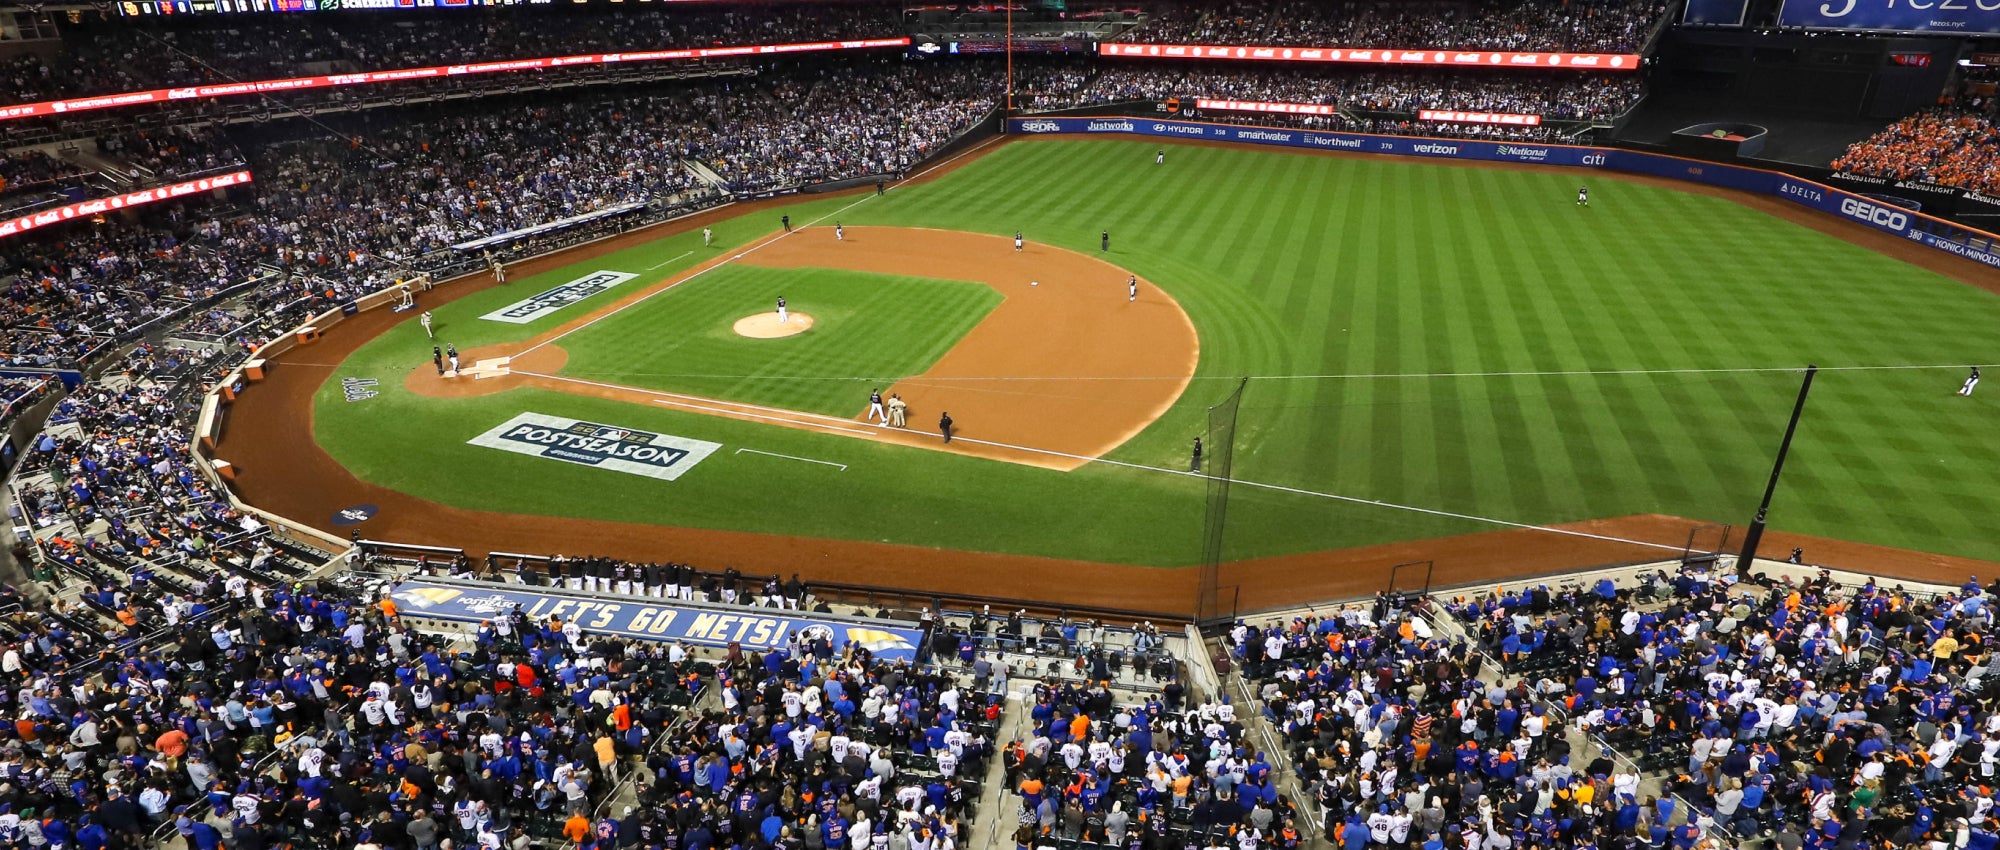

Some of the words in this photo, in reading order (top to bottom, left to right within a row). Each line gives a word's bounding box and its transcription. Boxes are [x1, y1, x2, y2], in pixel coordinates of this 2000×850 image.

[1930, 20, 1966, 28] tezos.nyc
[1088, 121, 1134, 131] Justworks
[1167, 125, 1204, 134] HYUNDAI
[1238, 130, 1291, 142] smartwater
[1314, 136, 1361, 148] Northwell
[1414, 143, 1457, 155] verizon
[1507, 146, 1547, 157] National
[1841, 172, 1864, 184] Coors
[1864, 176, 1886, 185] LIGHT
[1790, 185, 1821, 202] DELTA
[1905, 180, 1929, 192] Coors
[1930, 187, 1955, 195] LIGHT
[1841, 198, 1908, 231] GEICO
[1908, 229, 1923, 240] 380
[1935, 240, 1965, 255] KONICA
[1966, 250, 2000, 267] MINOLTA
[509, 426, 682, 465] POSTSEASON
[526, 597, 620, 628] LET'S
[628, 607, 678, 634] GO
[688, 612, 789, 645] METS!
[310, 756, 321, 766] 12
[459, 810, 470, 818] 20
[1374, 823, 1387, 831] 48
